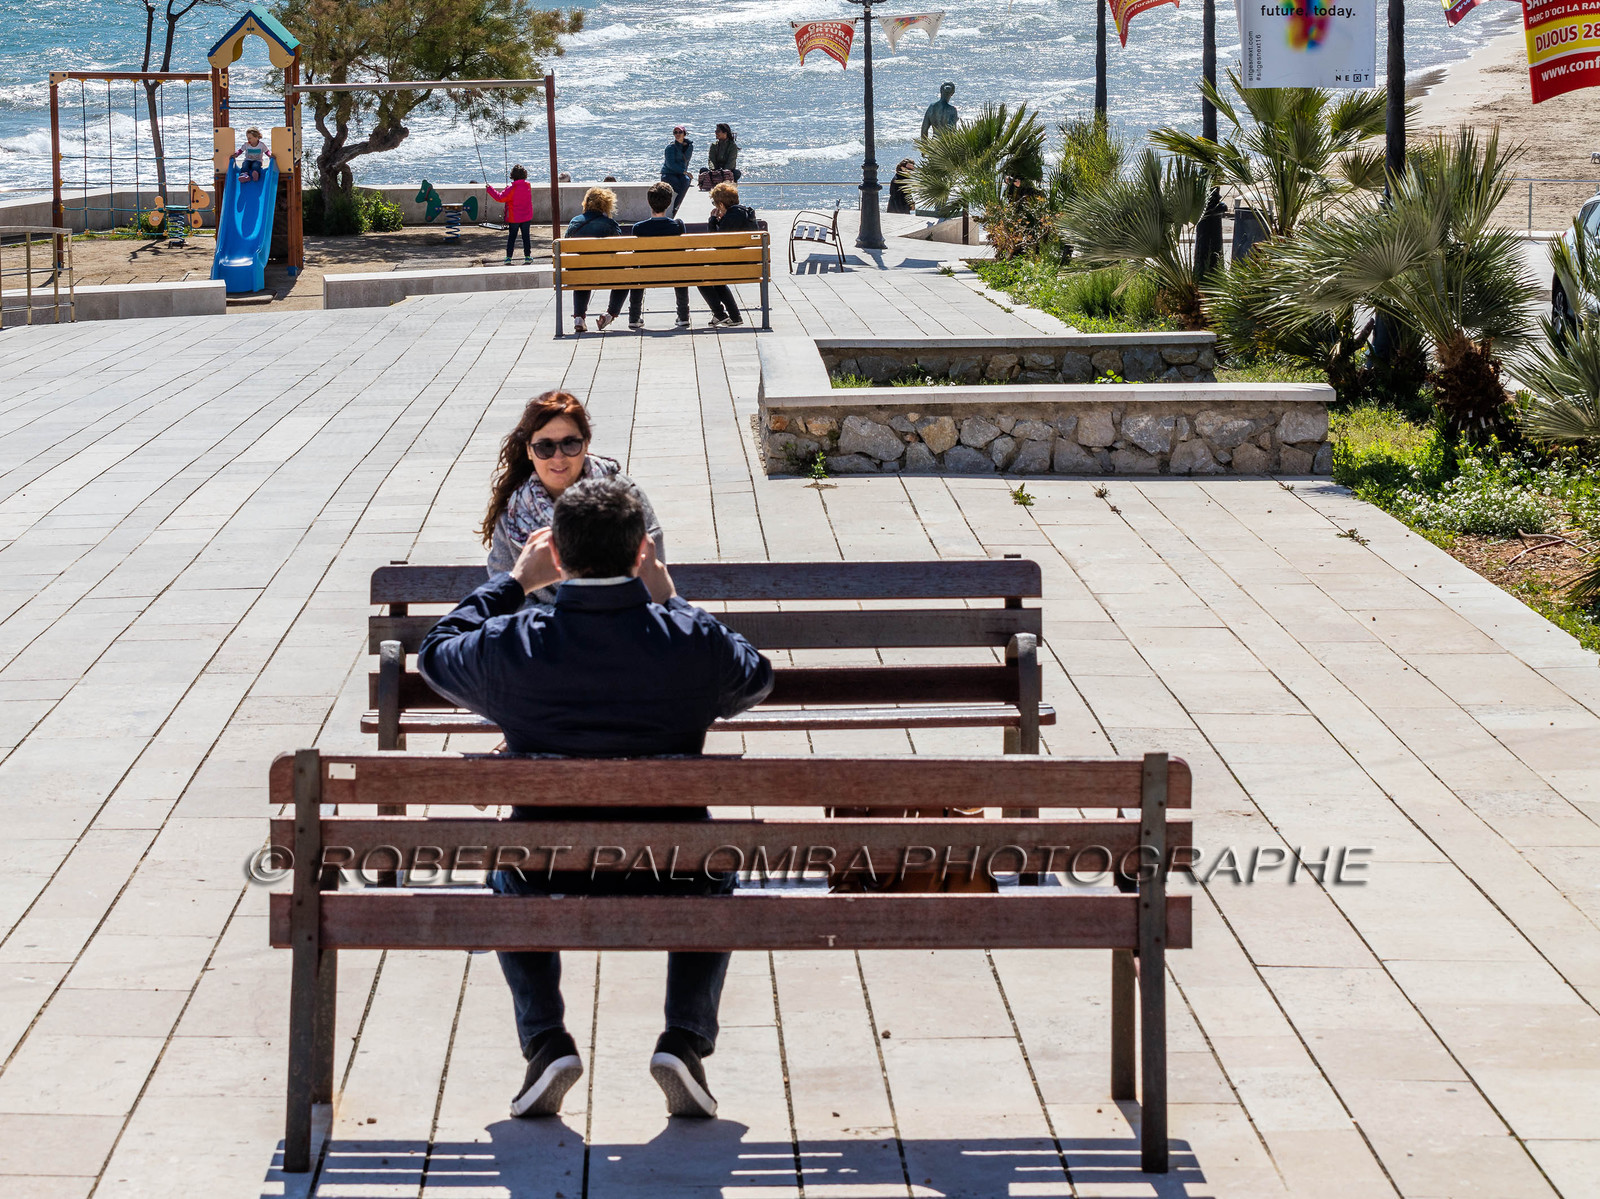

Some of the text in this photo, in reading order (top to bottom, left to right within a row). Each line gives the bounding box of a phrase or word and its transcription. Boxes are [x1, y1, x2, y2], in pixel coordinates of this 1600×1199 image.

[1261, 5, 1356, 18] future, today.
[1528, 12, 1544, 25] PARC
[1544, 6, 1565, 18] D'OCI
[1567, 3, 1580, 12] LA
[808, 23, 841, 32] GRAN
[1535, 22, 1600, 53] DIJOUS 28
